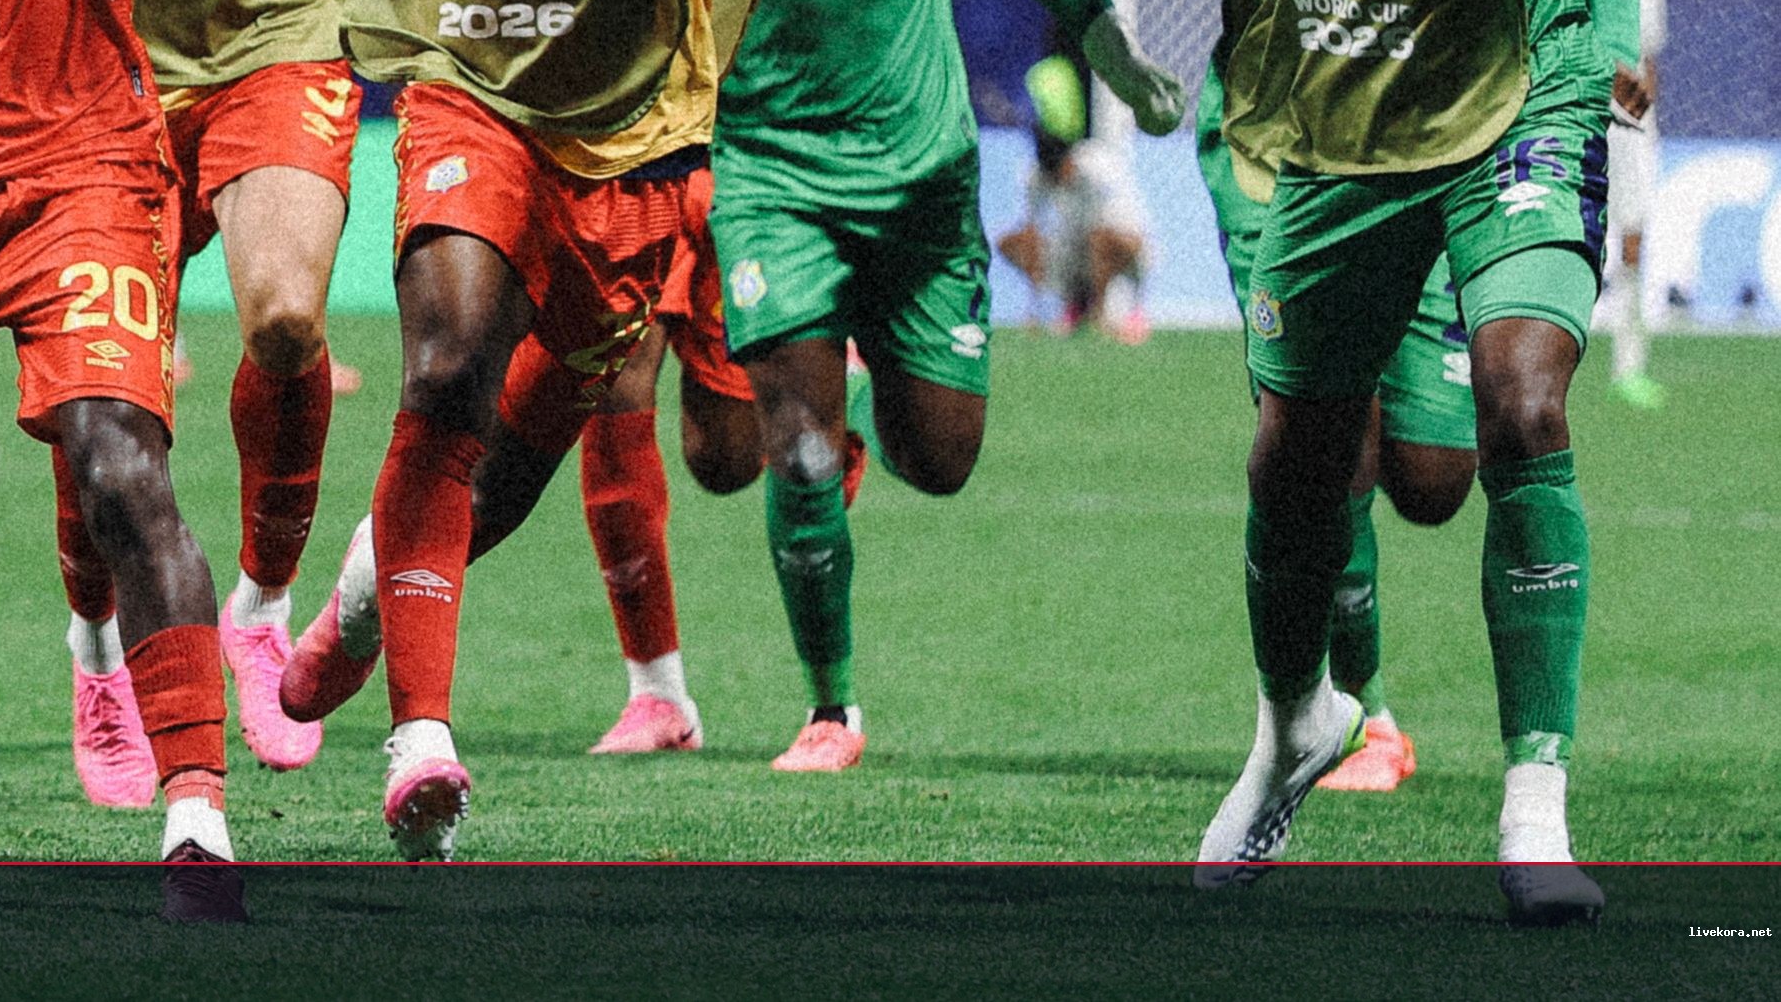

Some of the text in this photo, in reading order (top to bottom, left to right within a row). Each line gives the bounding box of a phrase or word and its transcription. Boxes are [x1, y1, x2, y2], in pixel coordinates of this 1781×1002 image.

[437, 1, 576, 40] 2026
[58, 260, 159, 341] 20
[394, 586, 453, 604] umbro
[1512, 579, 1579, 593] umbro
